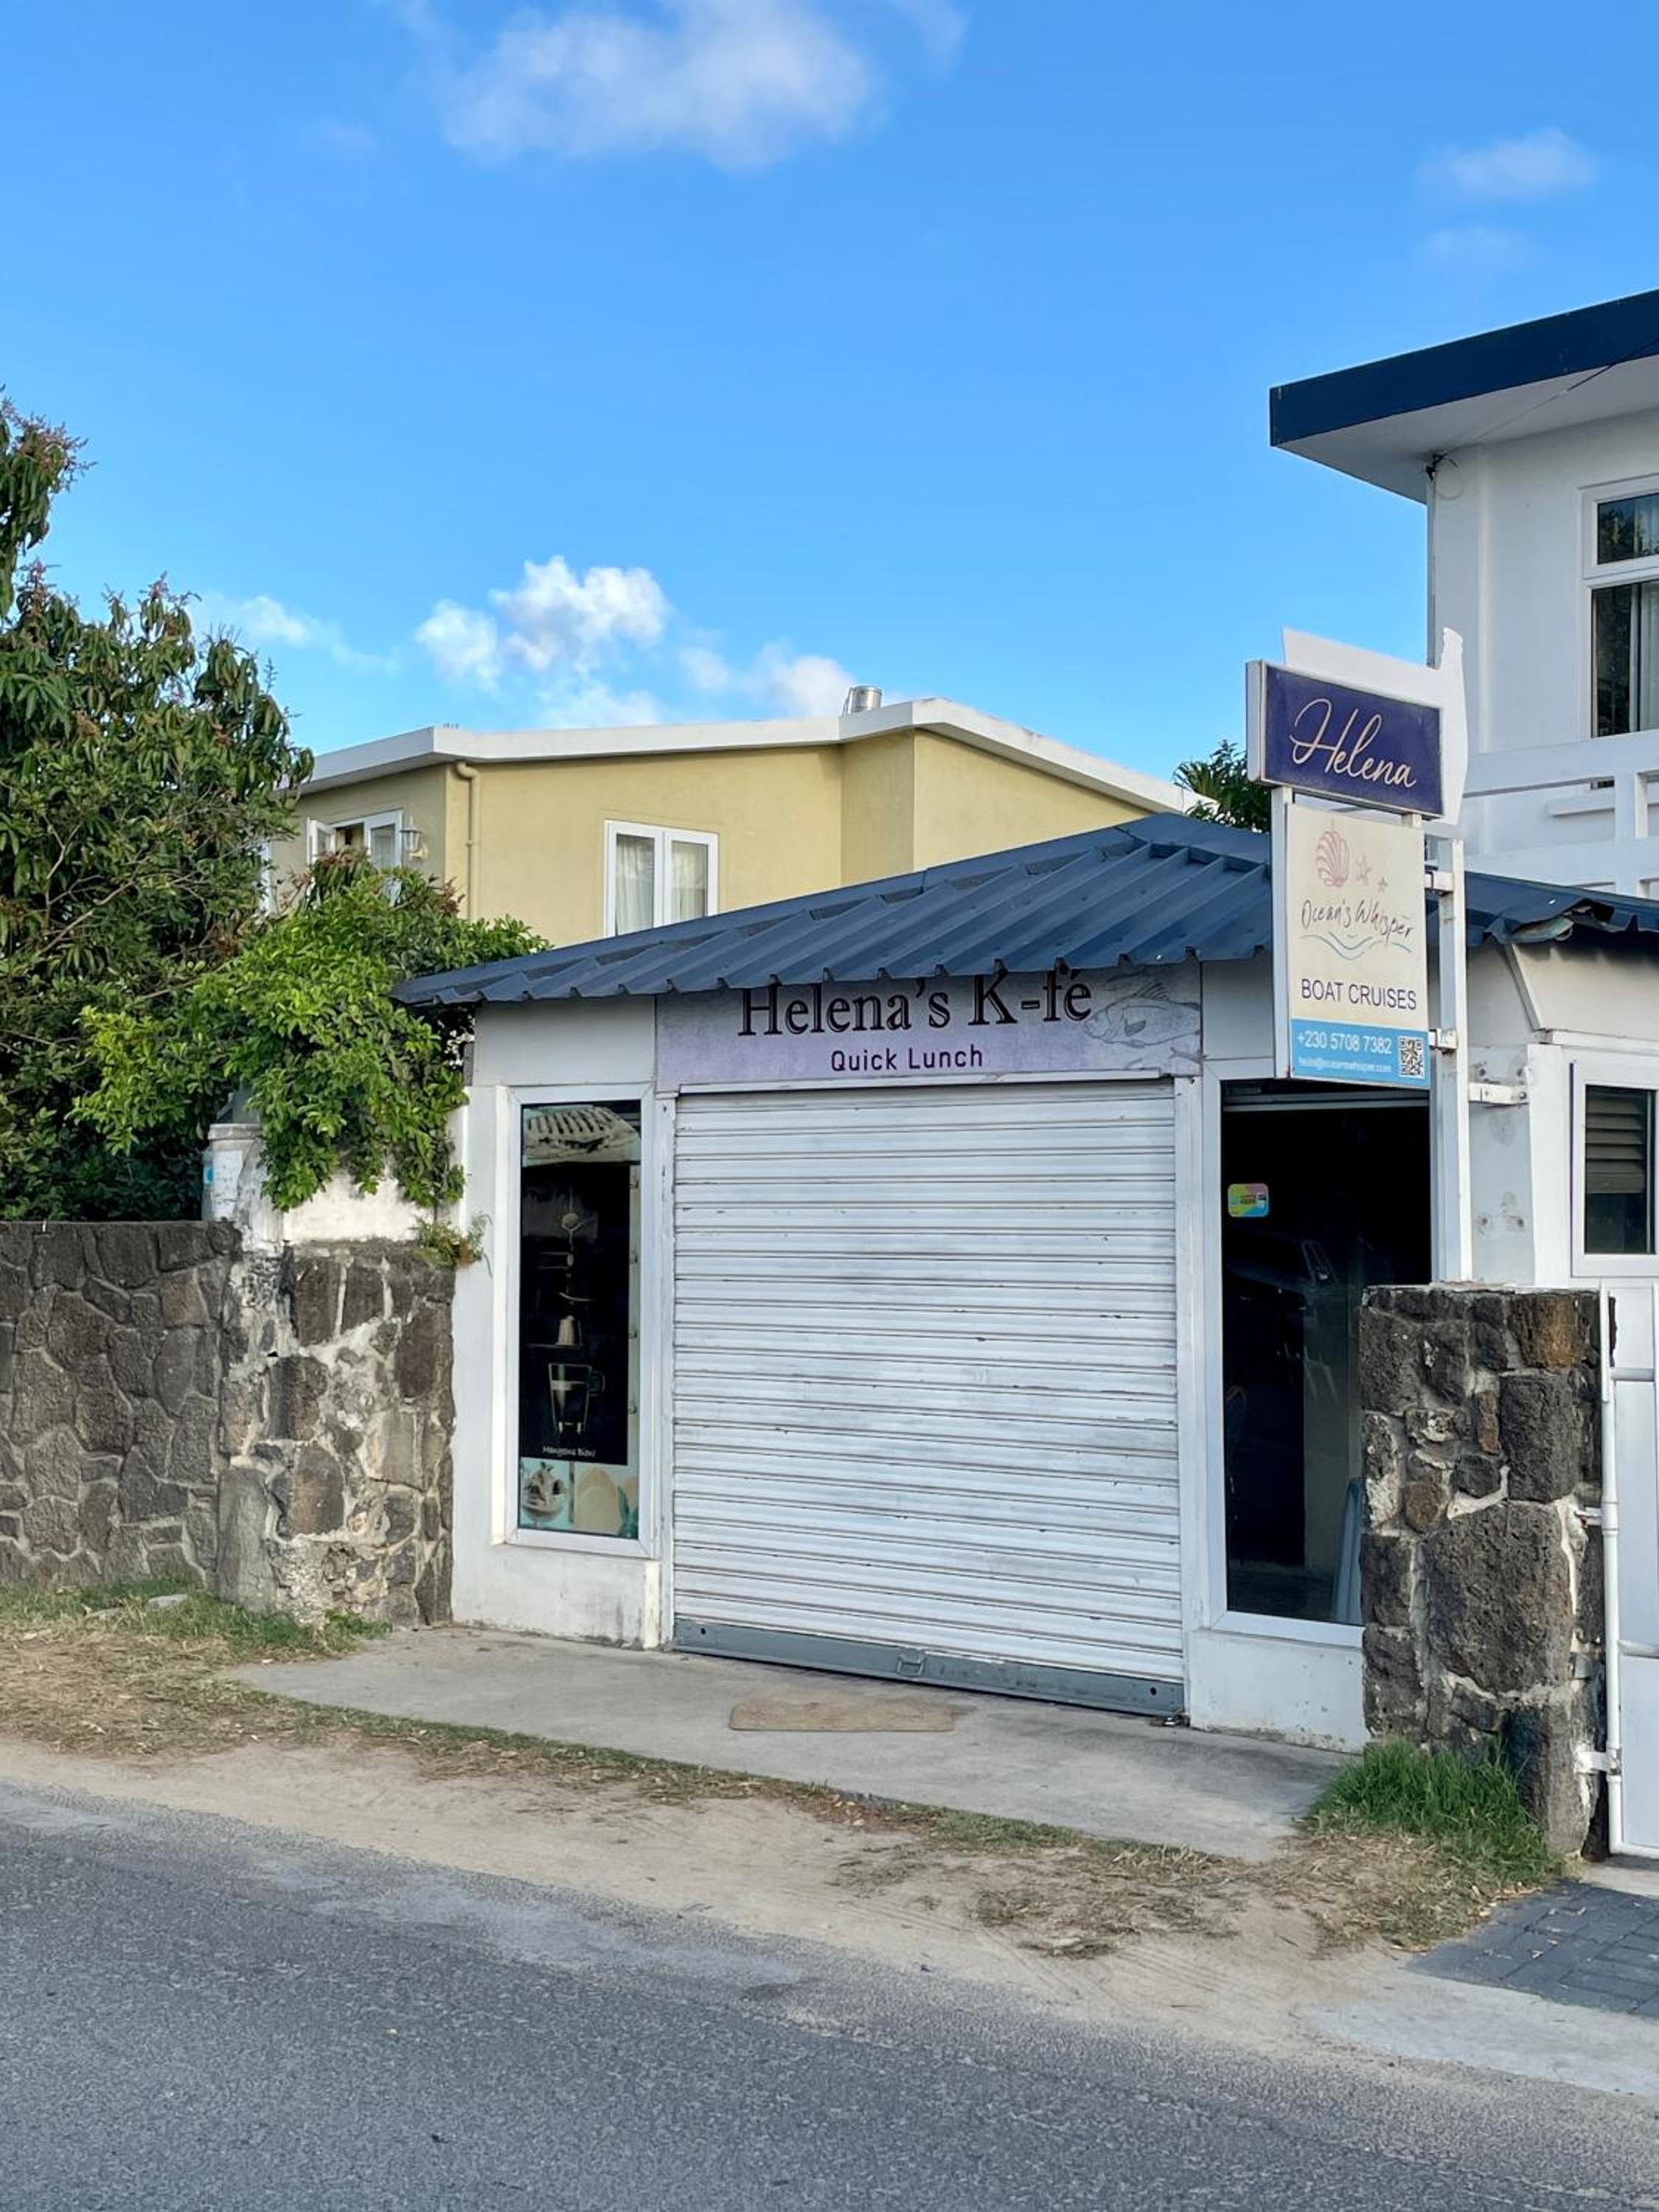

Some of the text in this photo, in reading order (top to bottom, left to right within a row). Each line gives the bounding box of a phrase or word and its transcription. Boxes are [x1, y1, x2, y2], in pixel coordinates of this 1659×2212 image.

[1290, 698, 1416, 787] Helena
[1301, 899, 1352, 929] Ocean's
[737, 977, 950, 1035] Helena's
[1301, 978, 1416, 1010] BOAT CRUISES
[831, 1043, 982, 1071] Quick Lunch
[1298, 1031, 1392, 1054] +230 5708 7382
